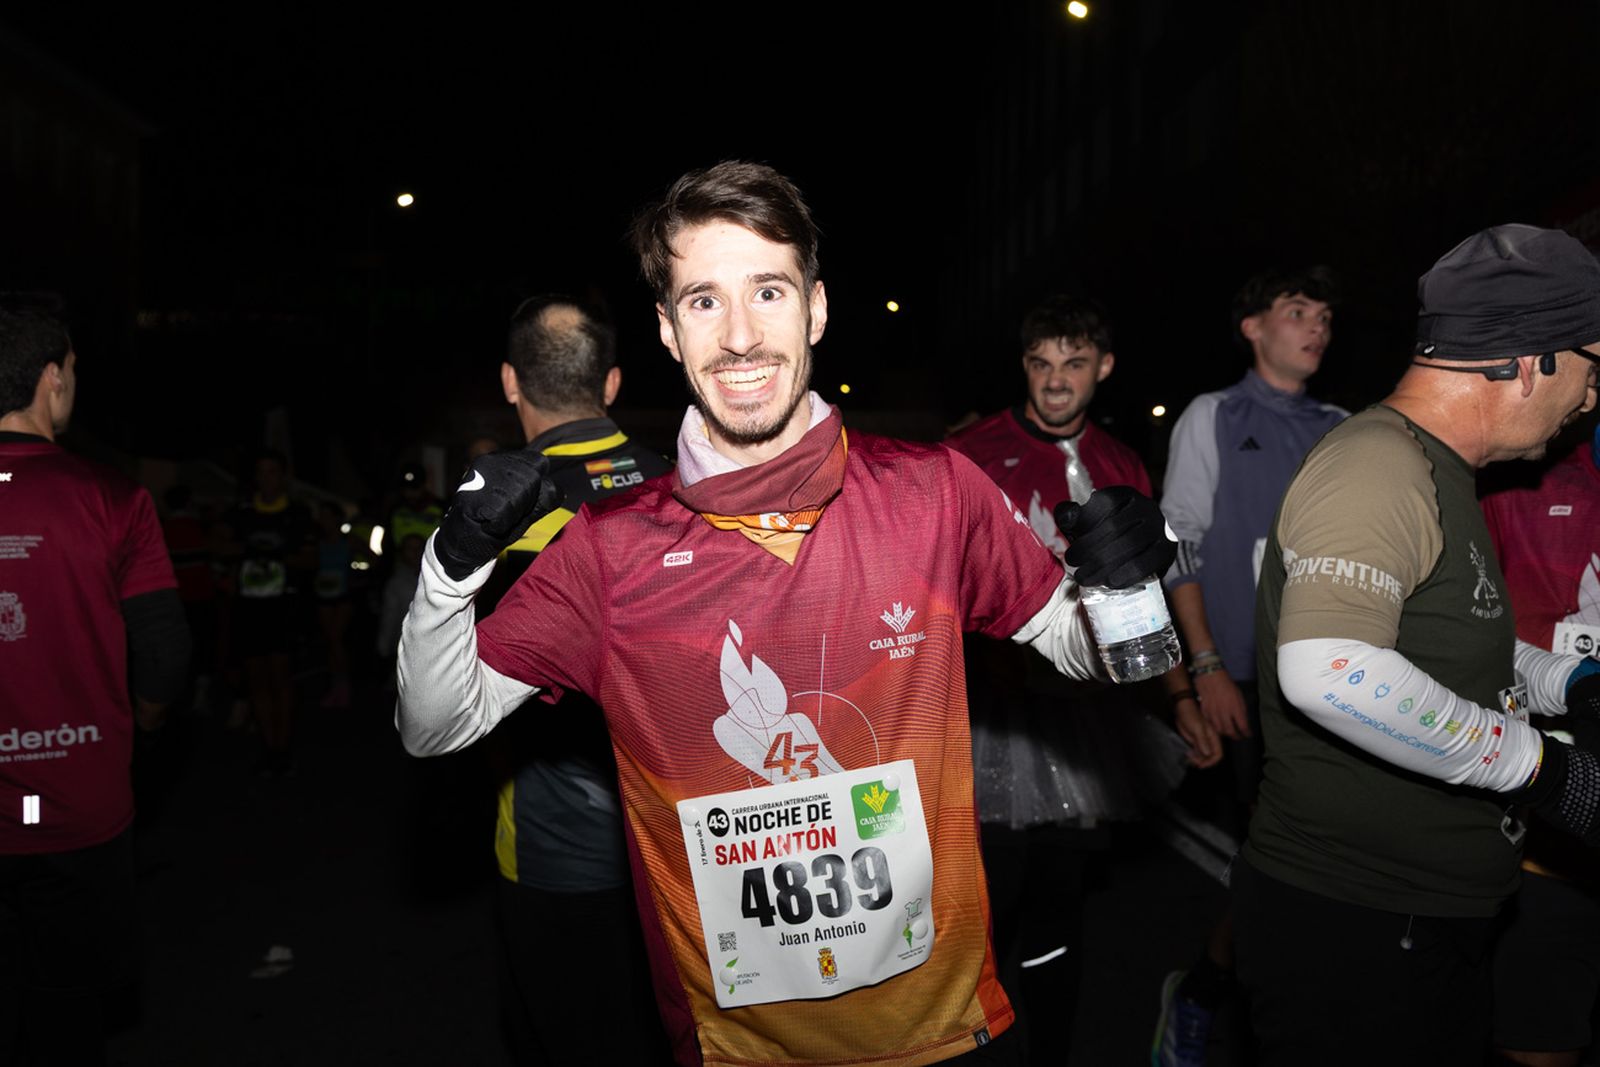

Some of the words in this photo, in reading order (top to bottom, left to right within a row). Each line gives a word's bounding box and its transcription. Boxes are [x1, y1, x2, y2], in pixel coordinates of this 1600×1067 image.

[590, 471, 644, 491] FOCUS
[665, 554, 691, 564] 42K
[869, 637, 896, 651] CAJA
[896, 630, 926, 646] RURAL
[1575, 637, 1592, 651] 43
[889, 645, 916, 661] JAÉN
[0, 722, 99, 752] derón
[763, 731, 819, 779] 43
[731, 805, 760, 816] CARRERA
[758, 800, 783, 811] URBANA
[783, 792, 830, 806] INTERNACIONAL
[708, 813, 729, 830] 43
[734, 806, 802, 836] NOCHE
[806, 800, 833, 823] DE
[714, 839, 757, 866] SAN
[762, 823, 837, 860] ANTÓN
[741, 846, 893, 928] 4839
[779, 932, 810, 946] Juan
[814, 921, 867, 942] Antonio
